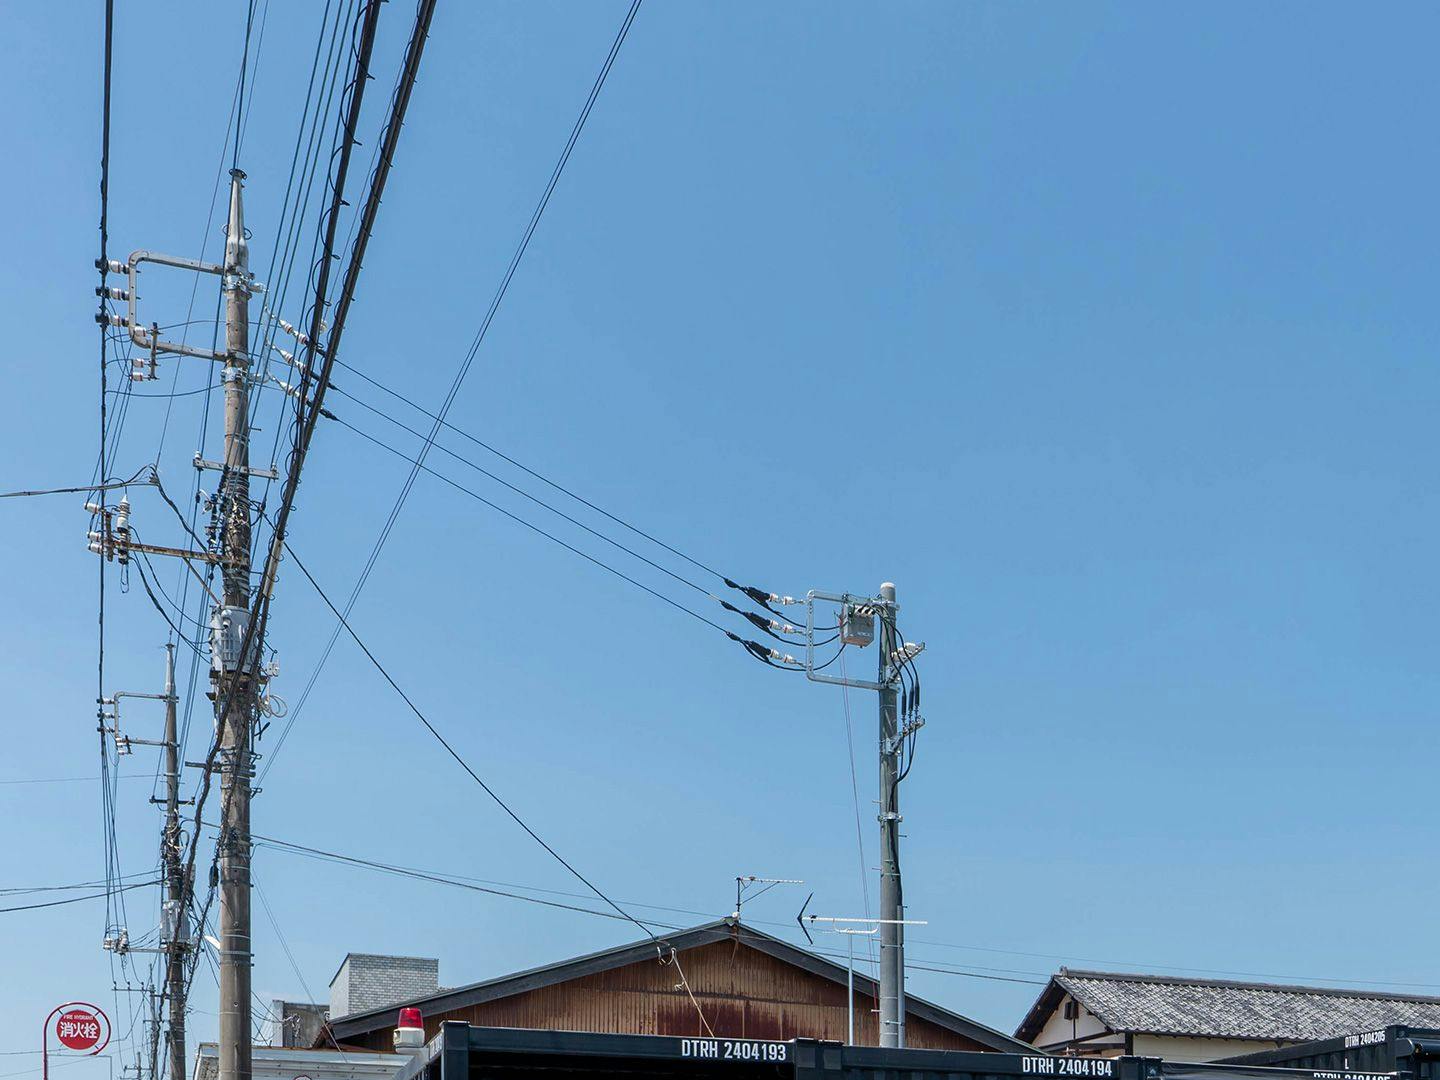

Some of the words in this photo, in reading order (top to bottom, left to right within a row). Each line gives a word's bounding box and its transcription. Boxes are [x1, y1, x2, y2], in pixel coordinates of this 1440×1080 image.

[60, 1021, 98, 1039] 消火栓
[1344, 1034, 1360, 1048] DTRH
[1360, 1030, 1386, 1045] 2404205
[681, 1039, 718, 1058] DTRH
[724, 1041, 786, 1061] 2404193
[1022, 1056, 1054, 1073] DTRH
[1059, 1059, 1112, 1077] 2404194
